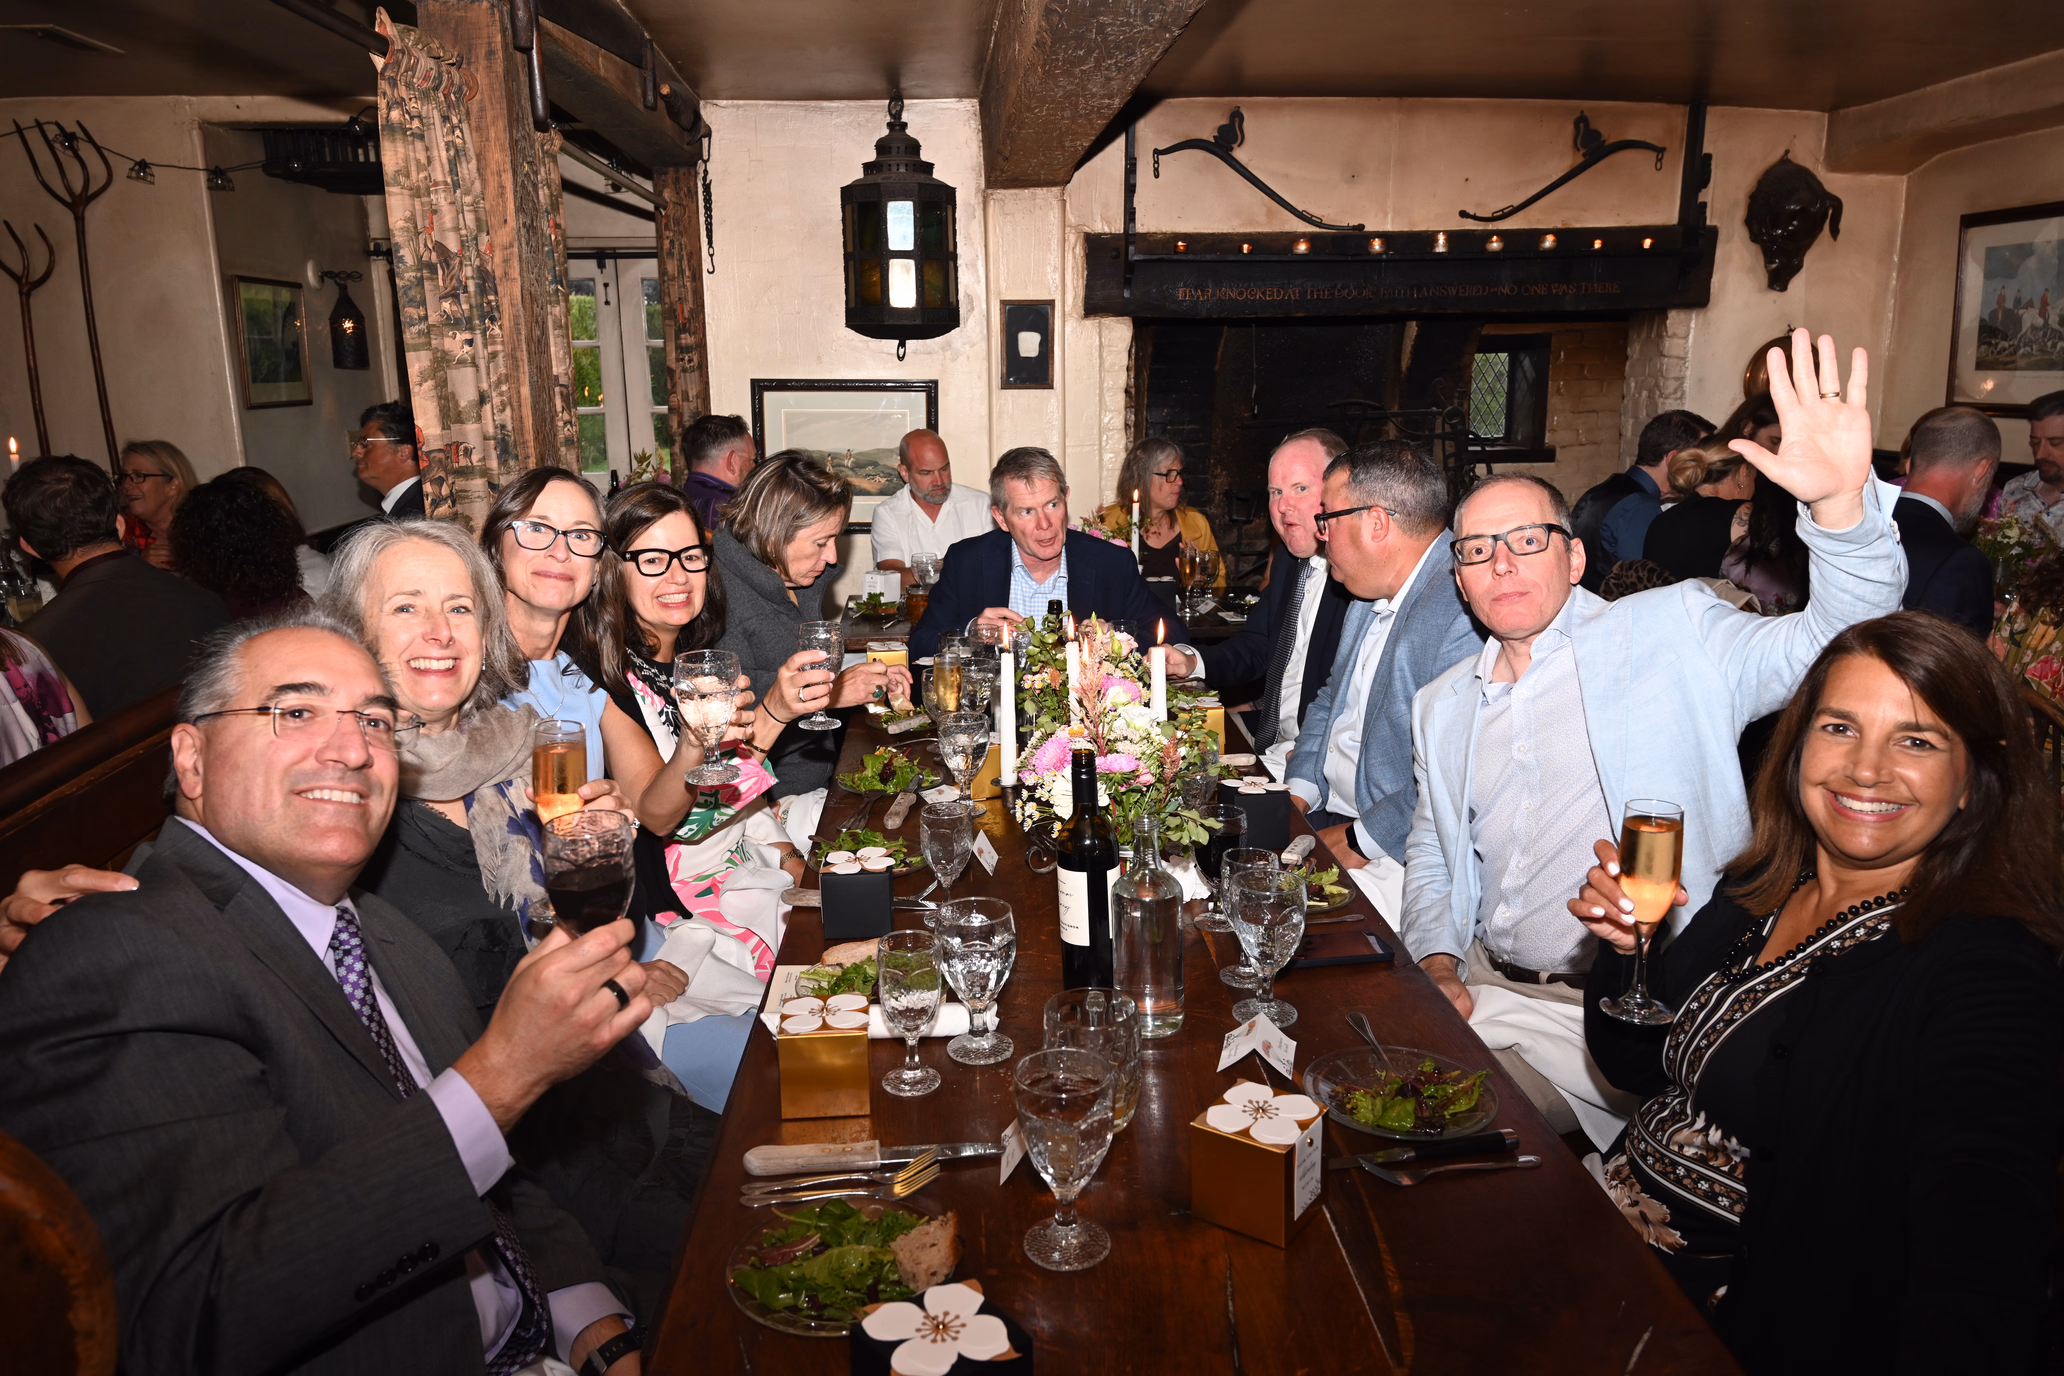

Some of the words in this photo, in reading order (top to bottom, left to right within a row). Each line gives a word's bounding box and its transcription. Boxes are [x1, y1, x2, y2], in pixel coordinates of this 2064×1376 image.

[1178, 287, 1212, 301] FEAR
[1216, 287, 1284, 300] KNOCKED
[1285, 287, 1300, 300] AT
[1306, 287, 1332, 300] THE
[1380, 286, 1417, 299] FAITH
[1521, 284, 1548, 296] ONE
[1550, 282, 1577, 296] WAS
[1579, 281, 1620, 294] THERE
